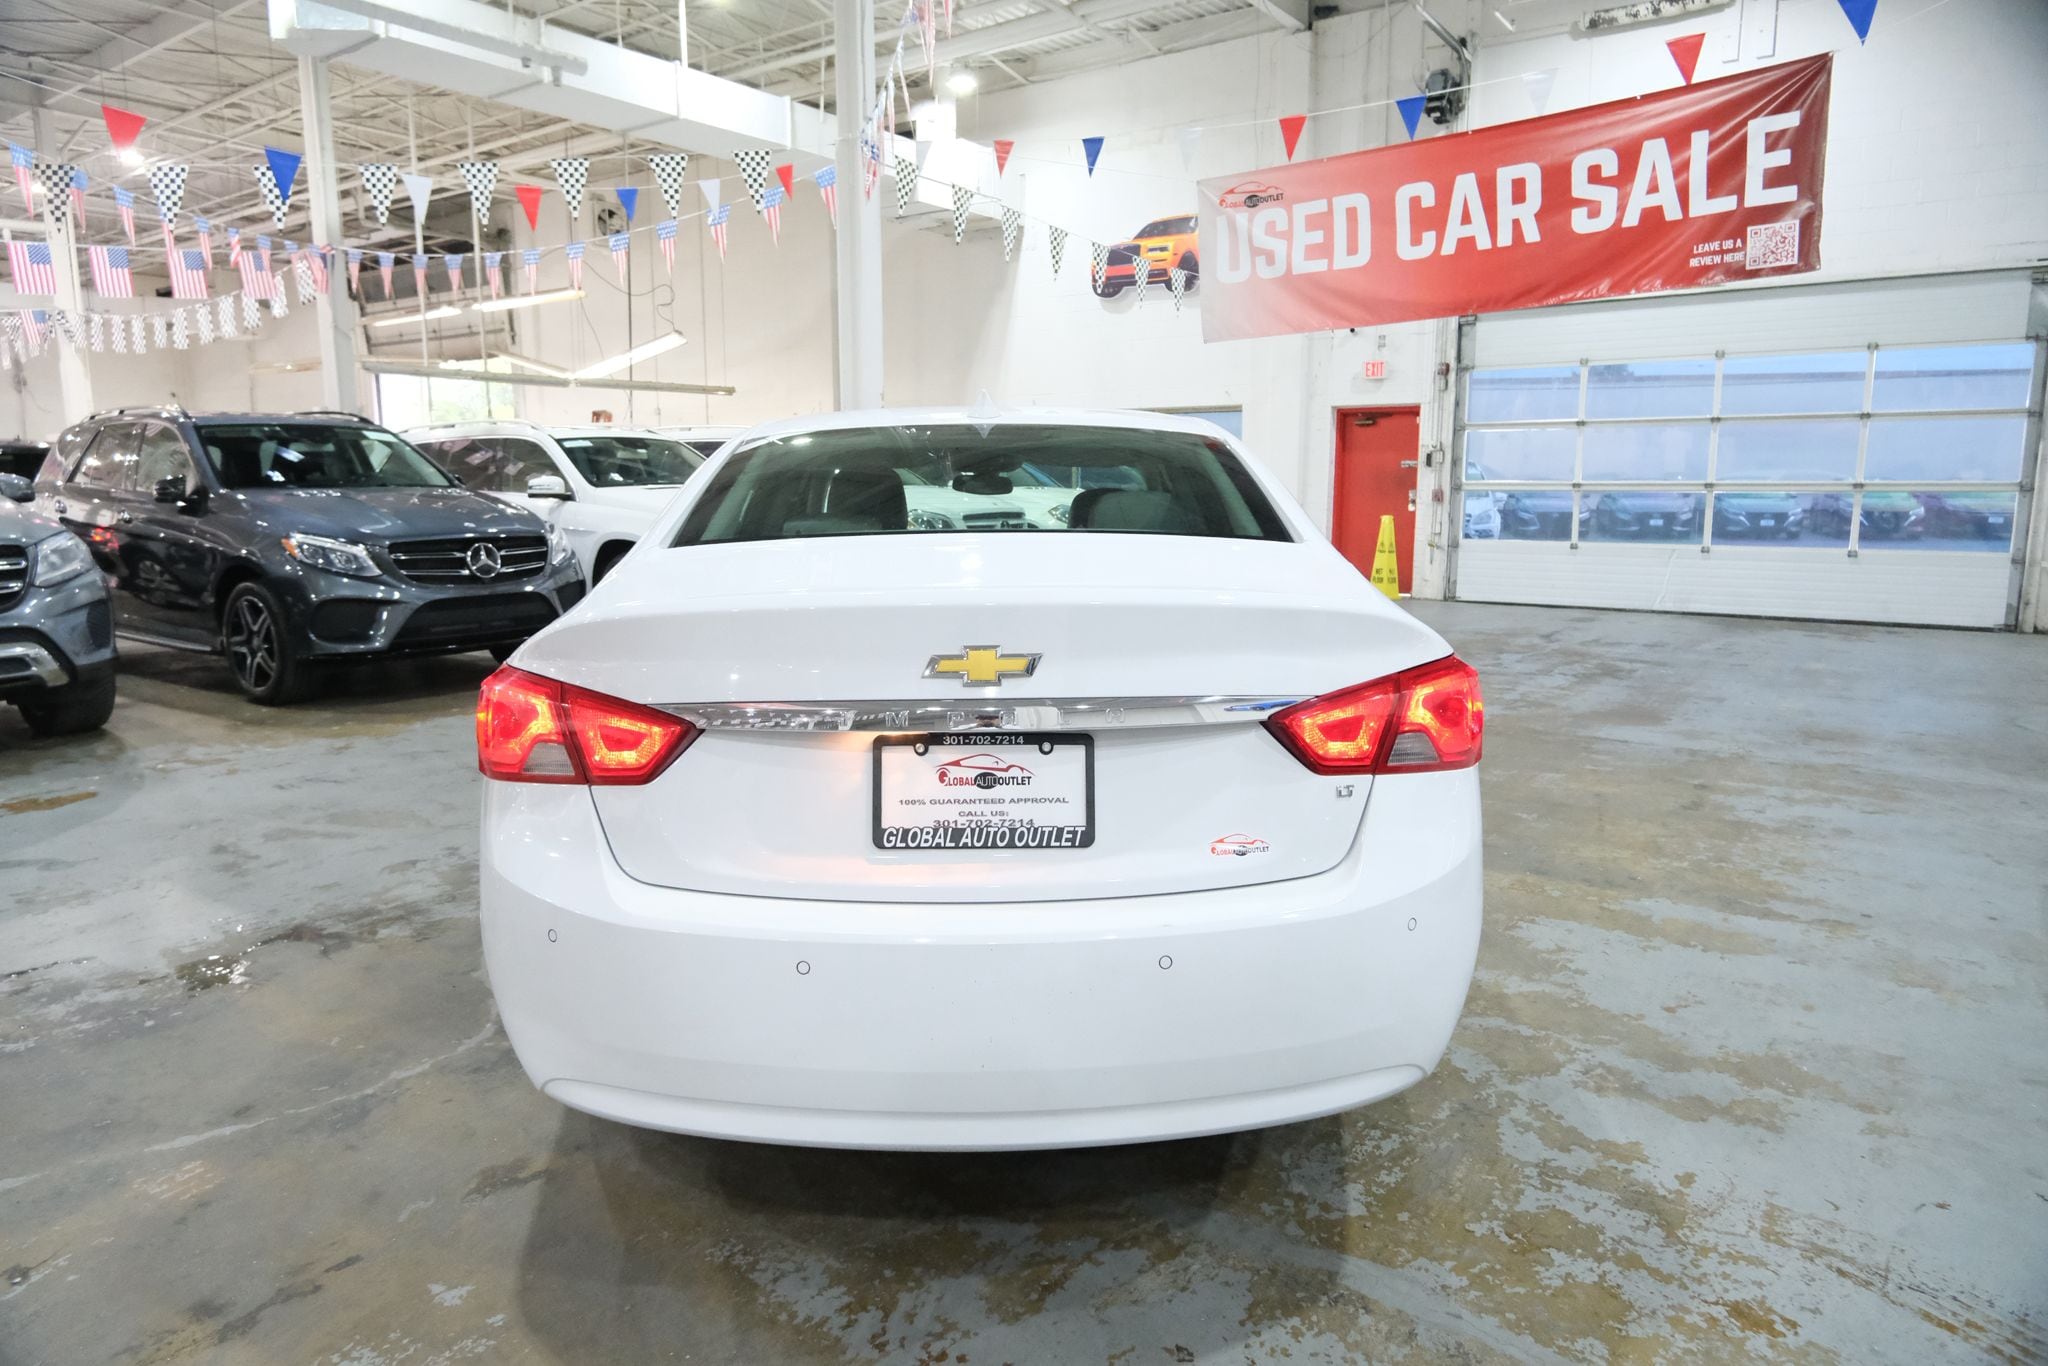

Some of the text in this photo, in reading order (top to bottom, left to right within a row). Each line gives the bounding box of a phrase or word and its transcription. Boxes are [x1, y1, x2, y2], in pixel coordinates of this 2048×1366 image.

[1216, 111, 1801, 284] USED CAR SALE
[1693, 238, 1742, 254] LEAVE US A
[1690, 251, 1745, 267] REVIEW HERE
[1365, 362, 1384, 377] EXIT
[943, 735, 1024, 745] 301-702-7214
[933, 818, 1035, 828] 301-702-7214
[883, 826, 1086, 847] GLOBAL AUTO OUTLET
